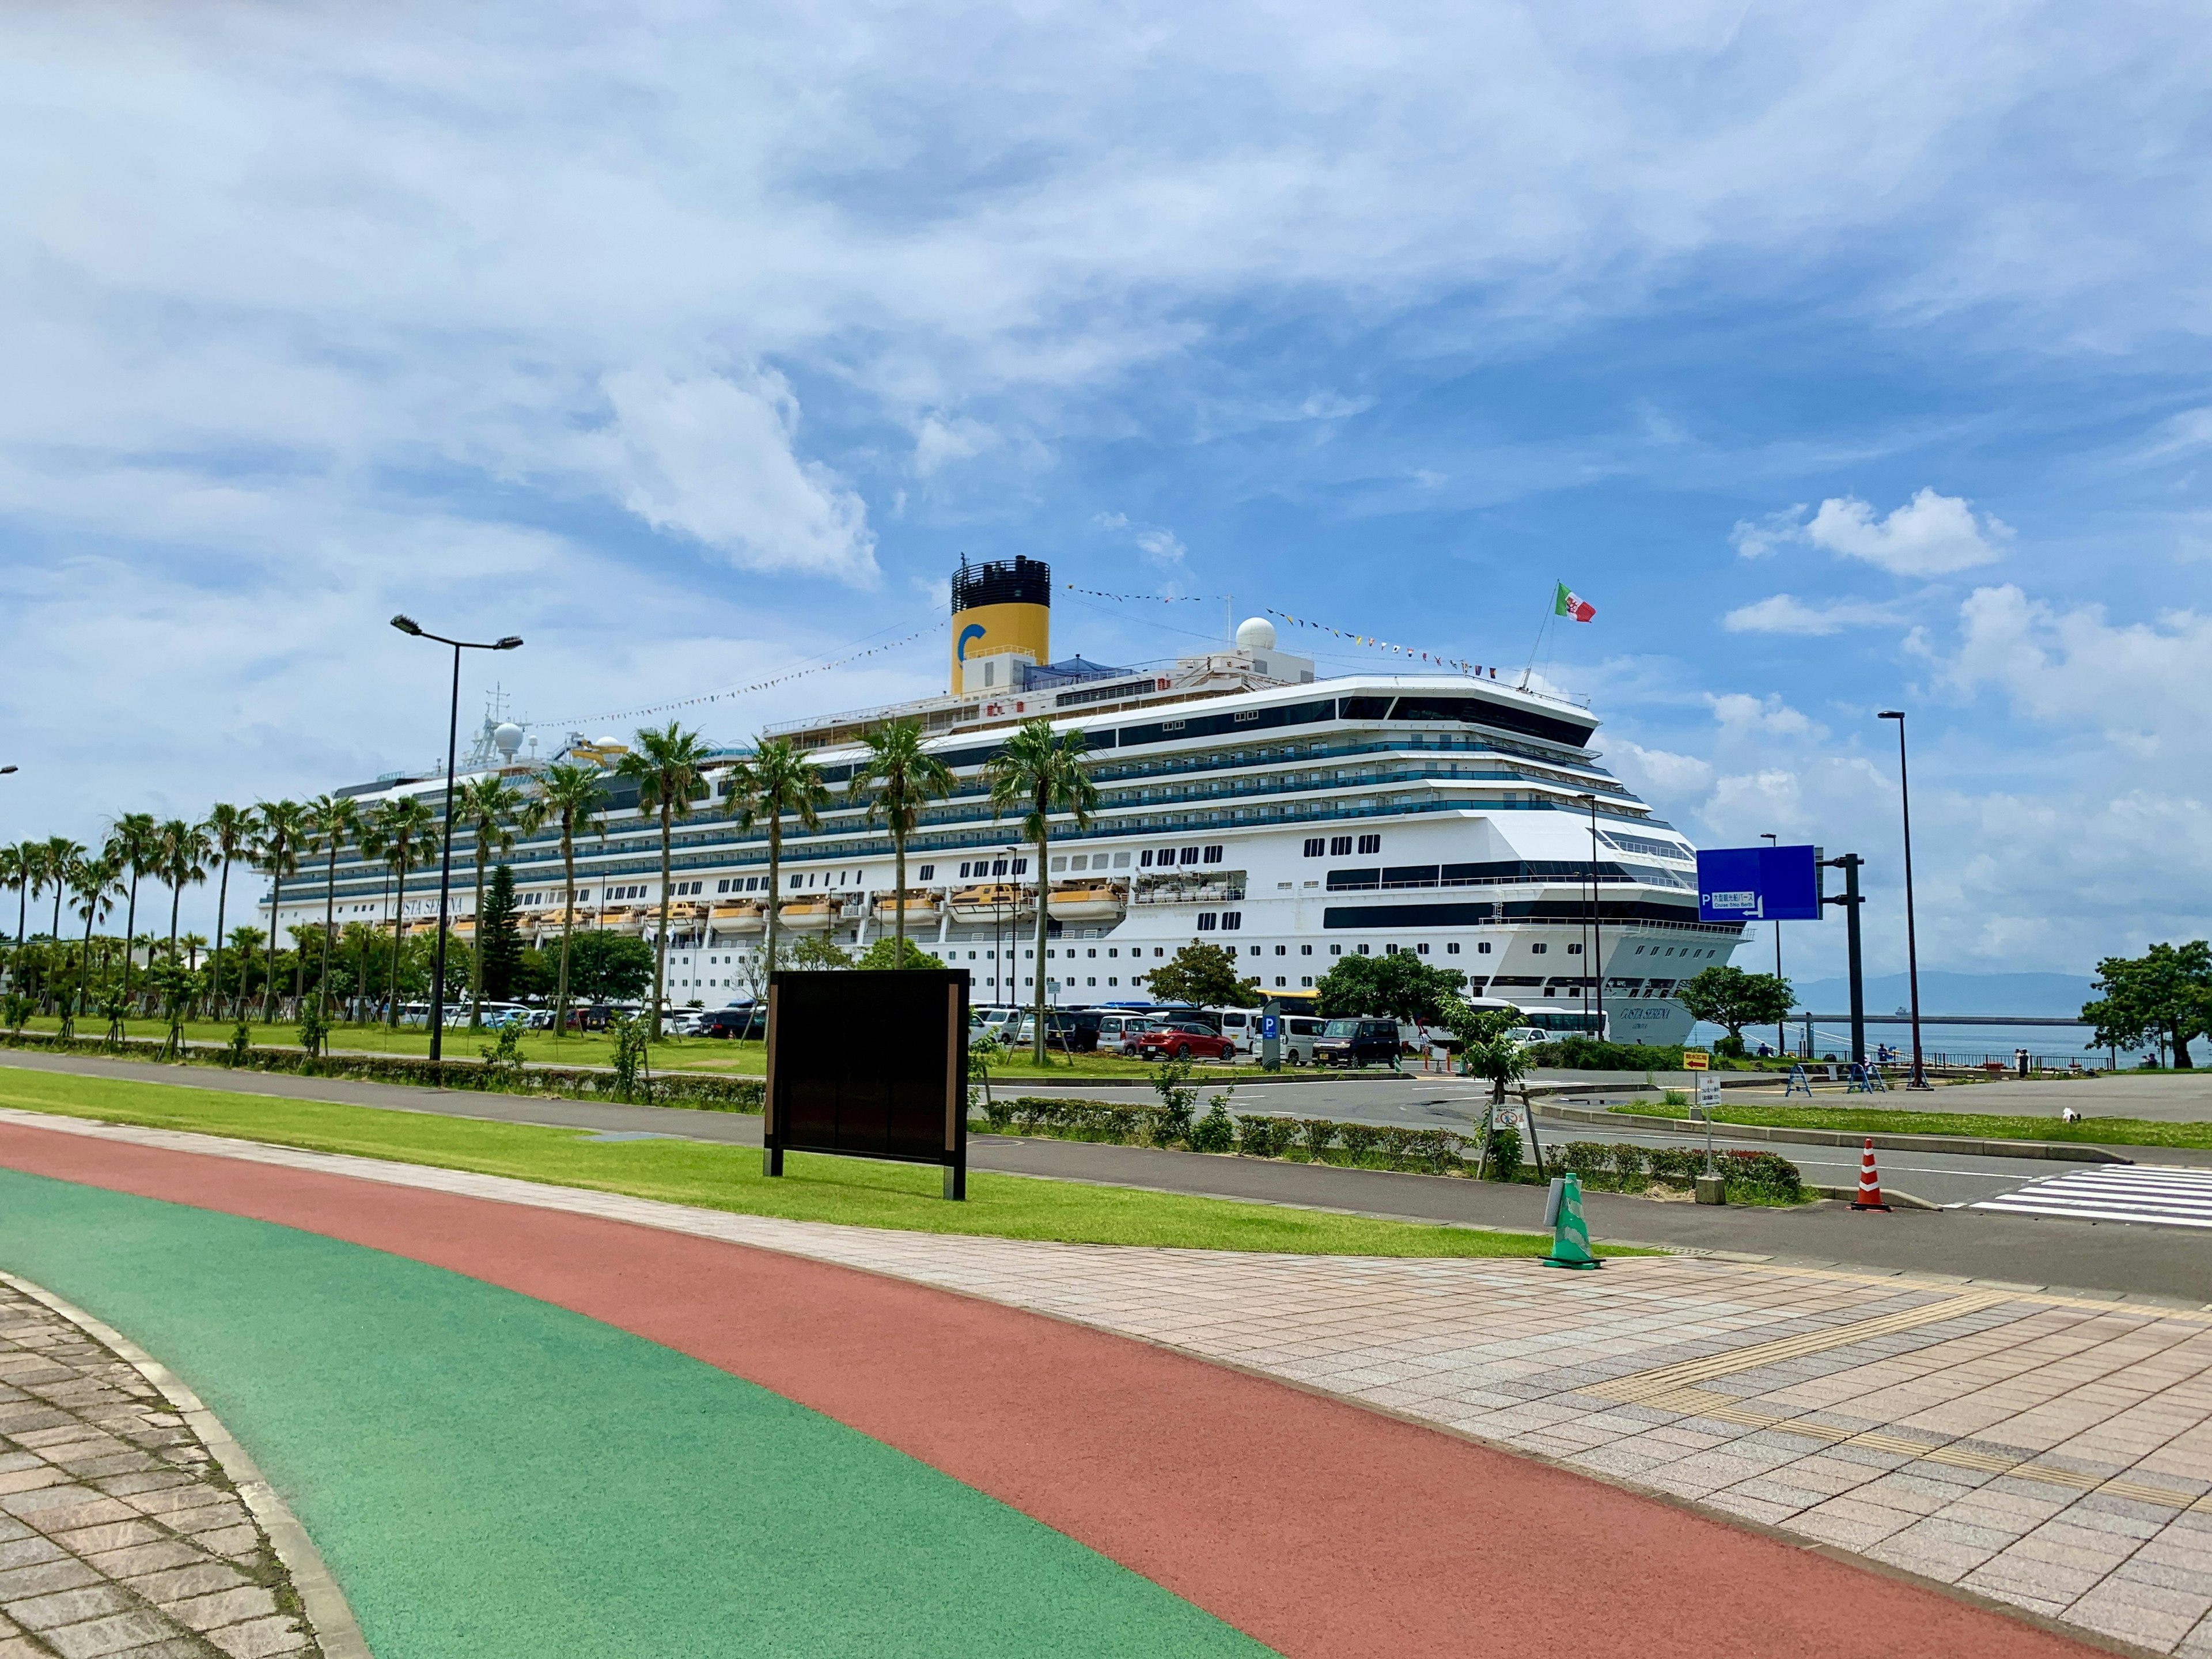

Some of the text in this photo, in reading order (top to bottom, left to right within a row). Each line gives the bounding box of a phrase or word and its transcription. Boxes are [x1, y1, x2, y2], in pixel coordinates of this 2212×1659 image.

[1702, 893, 1711, 906] P
[1619, 1008, 1671, 1019] COSTA SERENA
[1266, 1018, 1274, 1031] P
